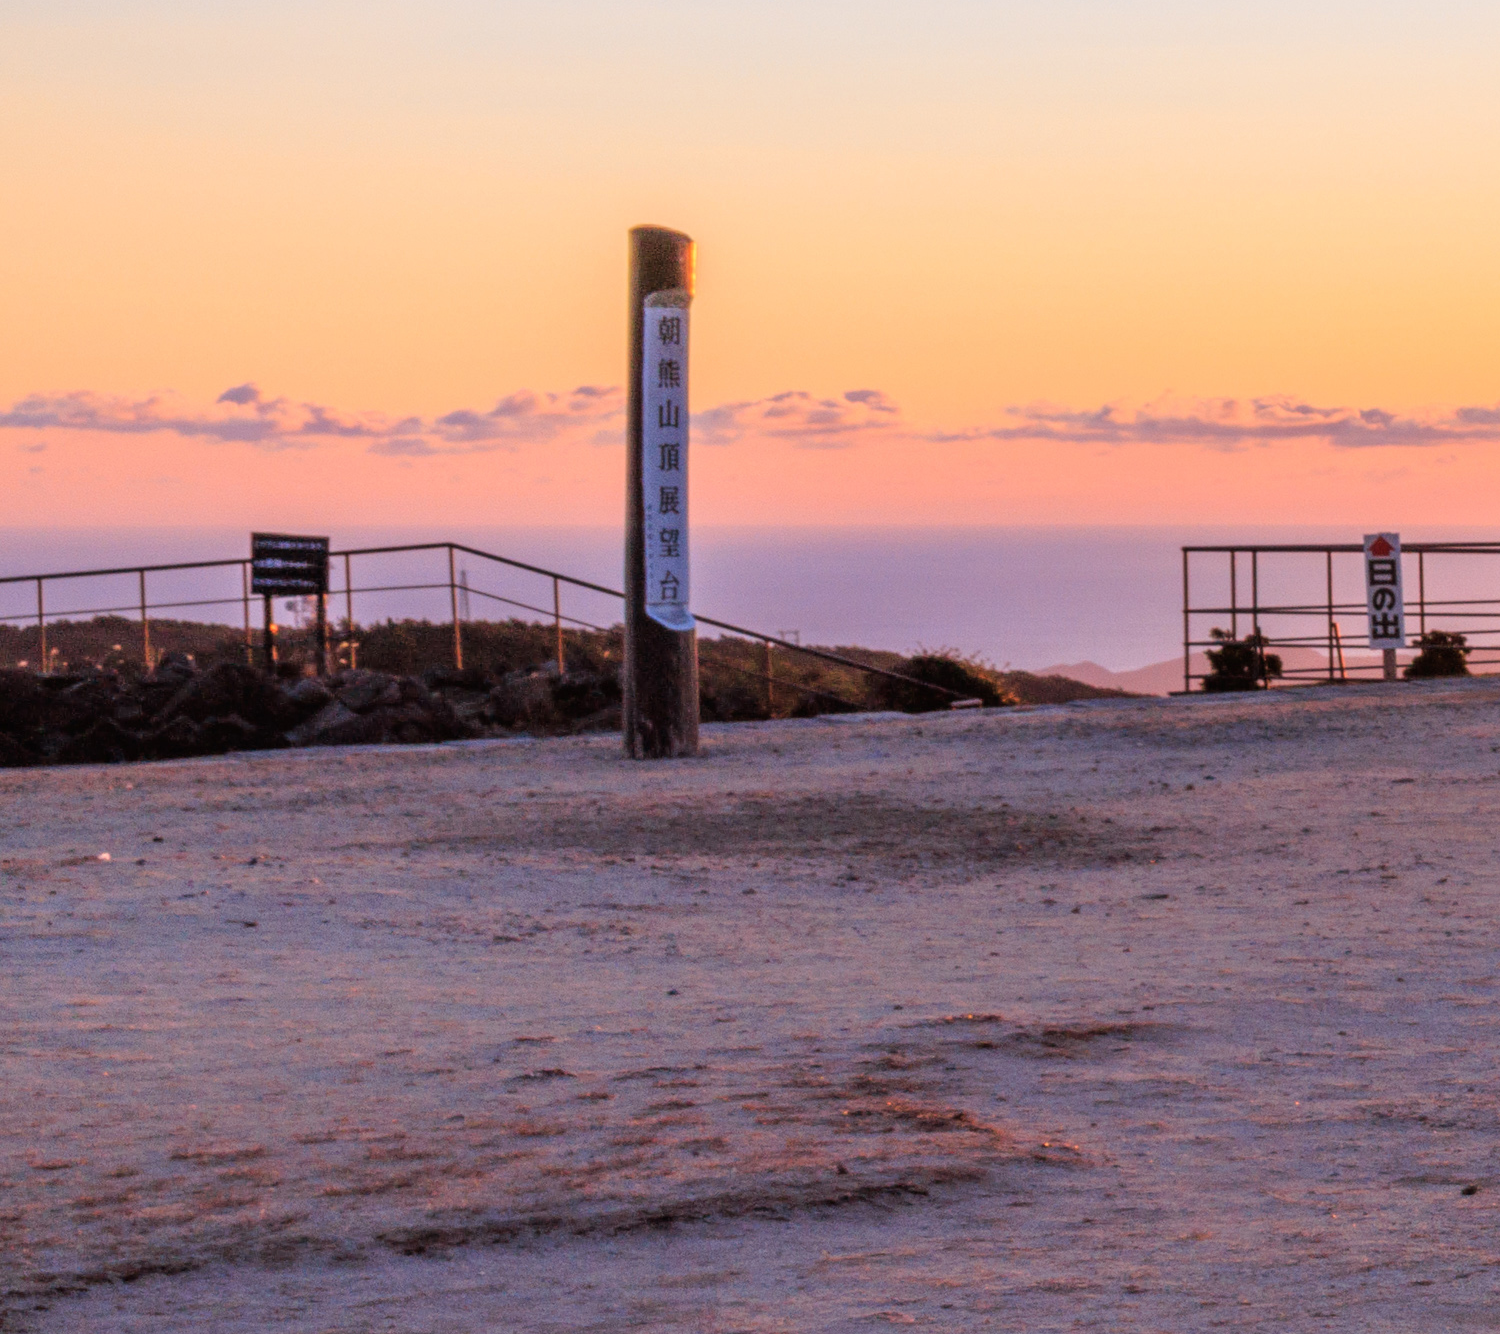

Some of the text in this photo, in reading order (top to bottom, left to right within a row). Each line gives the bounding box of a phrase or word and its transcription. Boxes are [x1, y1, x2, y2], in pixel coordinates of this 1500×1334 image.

[658, 315, 681, 600] 朝熊山頂展望台
[1368, 559, 1400, 639] 日の出
